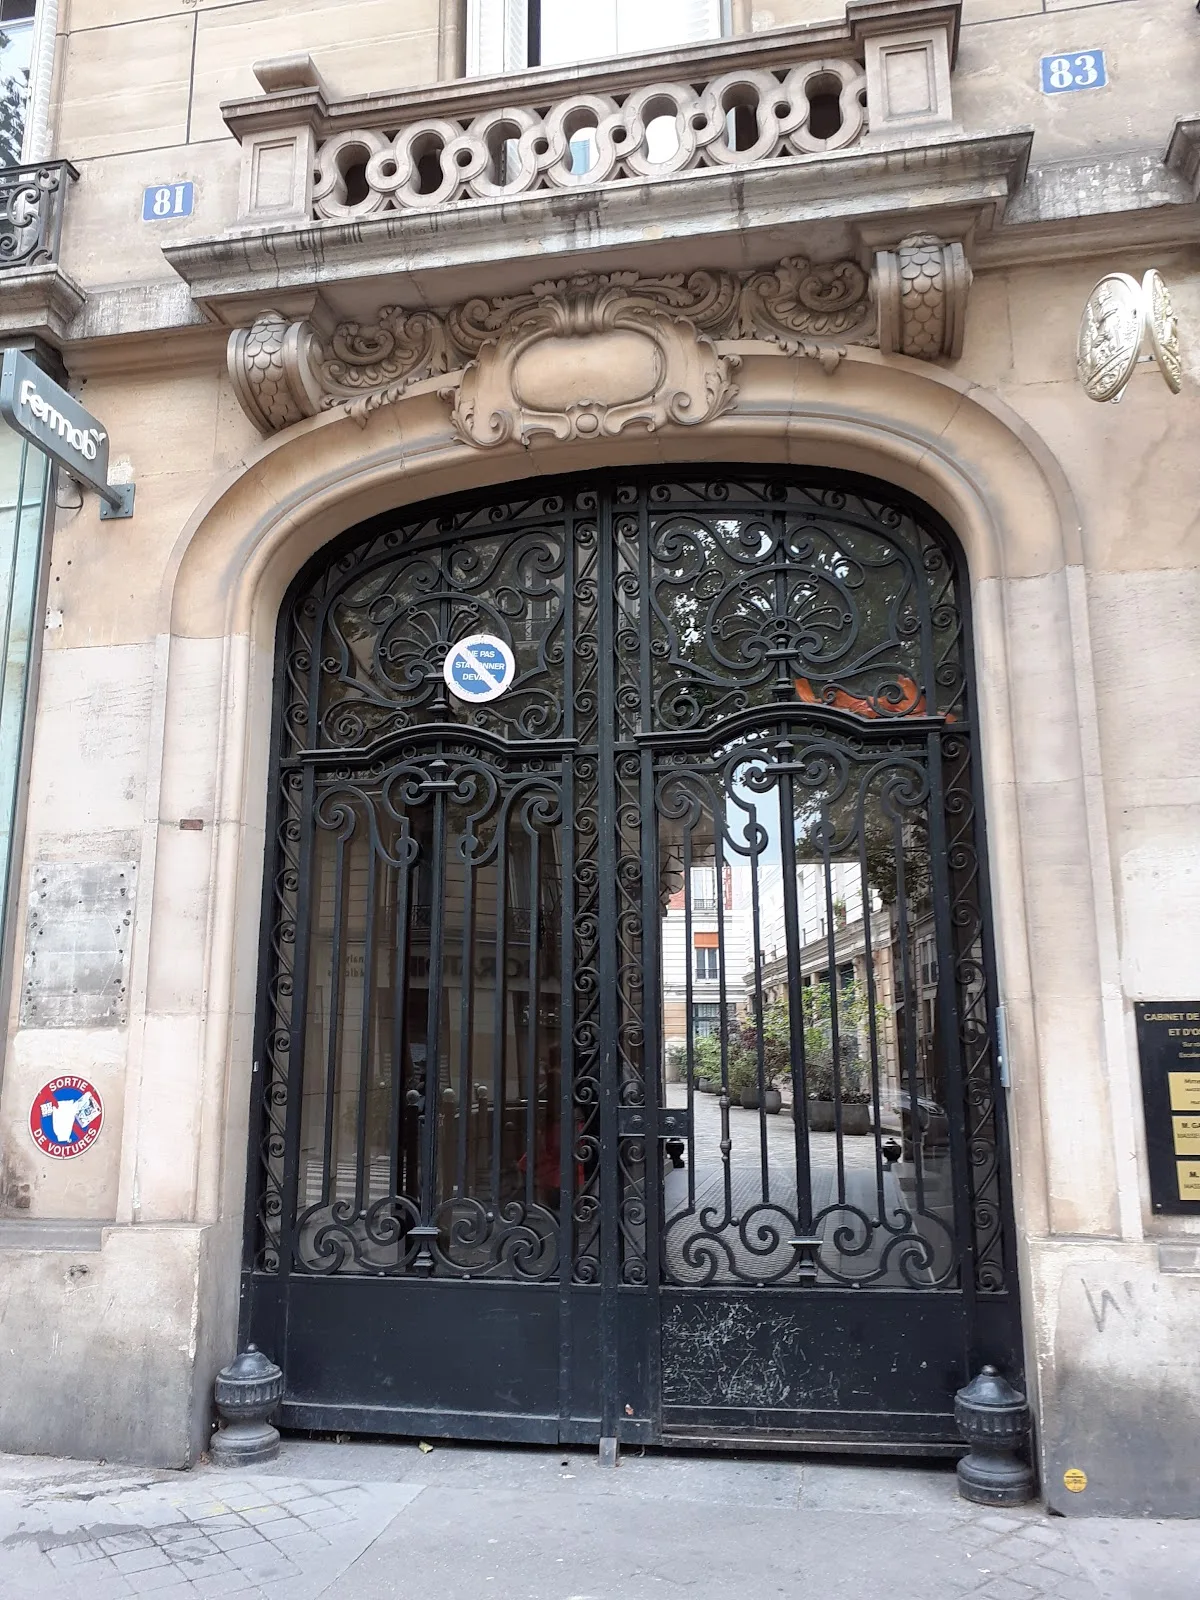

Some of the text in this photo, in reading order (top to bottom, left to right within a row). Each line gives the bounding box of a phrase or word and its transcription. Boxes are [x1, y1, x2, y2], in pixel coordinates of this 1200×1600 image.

[1049, 54, 1098, 88] 83
[153, 186, 185, 215] 81
[20, 380, 97, 460] Fermob
[455, 661, 505, 670] STANNER
[462, 673, 496, 681] DEVAT
[1143, 1012, 1200, 1021] CABINET DE
[1168, 1028, 1182, 1036] ET
[49, 1077, 88, 1092] SORTIE
[33, 1127, 97, 1156] DE VOITURES
